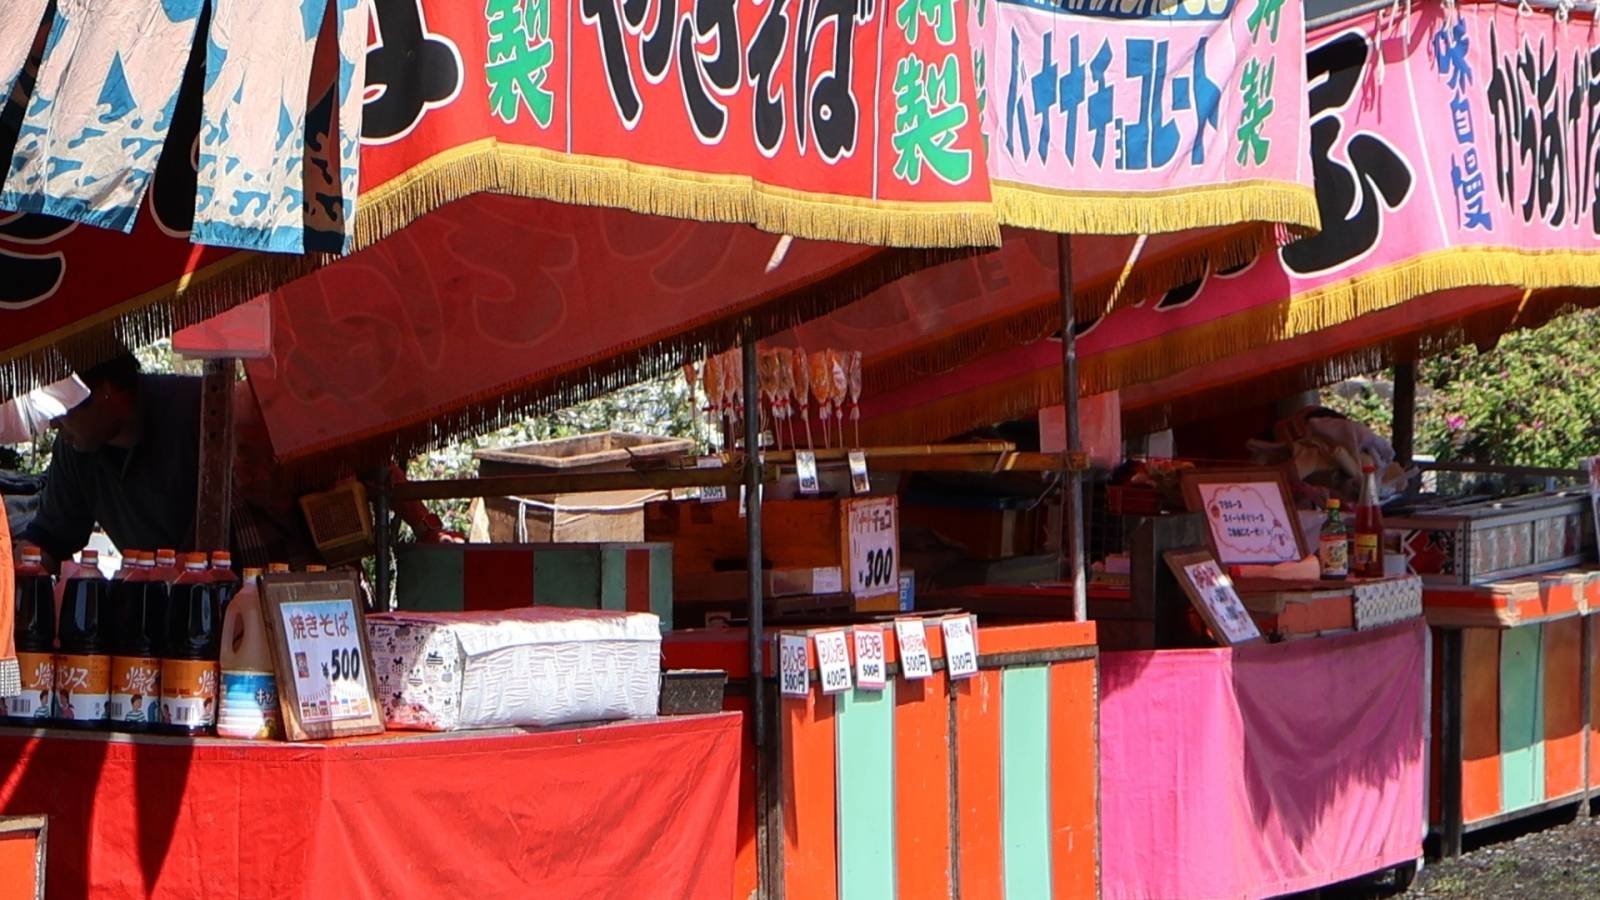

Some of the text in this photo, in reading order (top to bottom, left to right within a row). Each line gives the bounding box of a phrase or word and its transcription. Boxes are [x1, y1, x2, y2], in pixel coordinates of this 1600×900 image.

[1432, 15, 1493, 231] 味自慢
[1487, 18, 1600, 236] からあげ
[289, 612, 350, 640] 焼きそば
[863, 663, 880, 678] 500円
[905, 653, 928, 673] 500円
[951, 651, 973, 672] 500円
[784, 672, 806, 693] 500円
[826, 667, 848, 687] 400円
